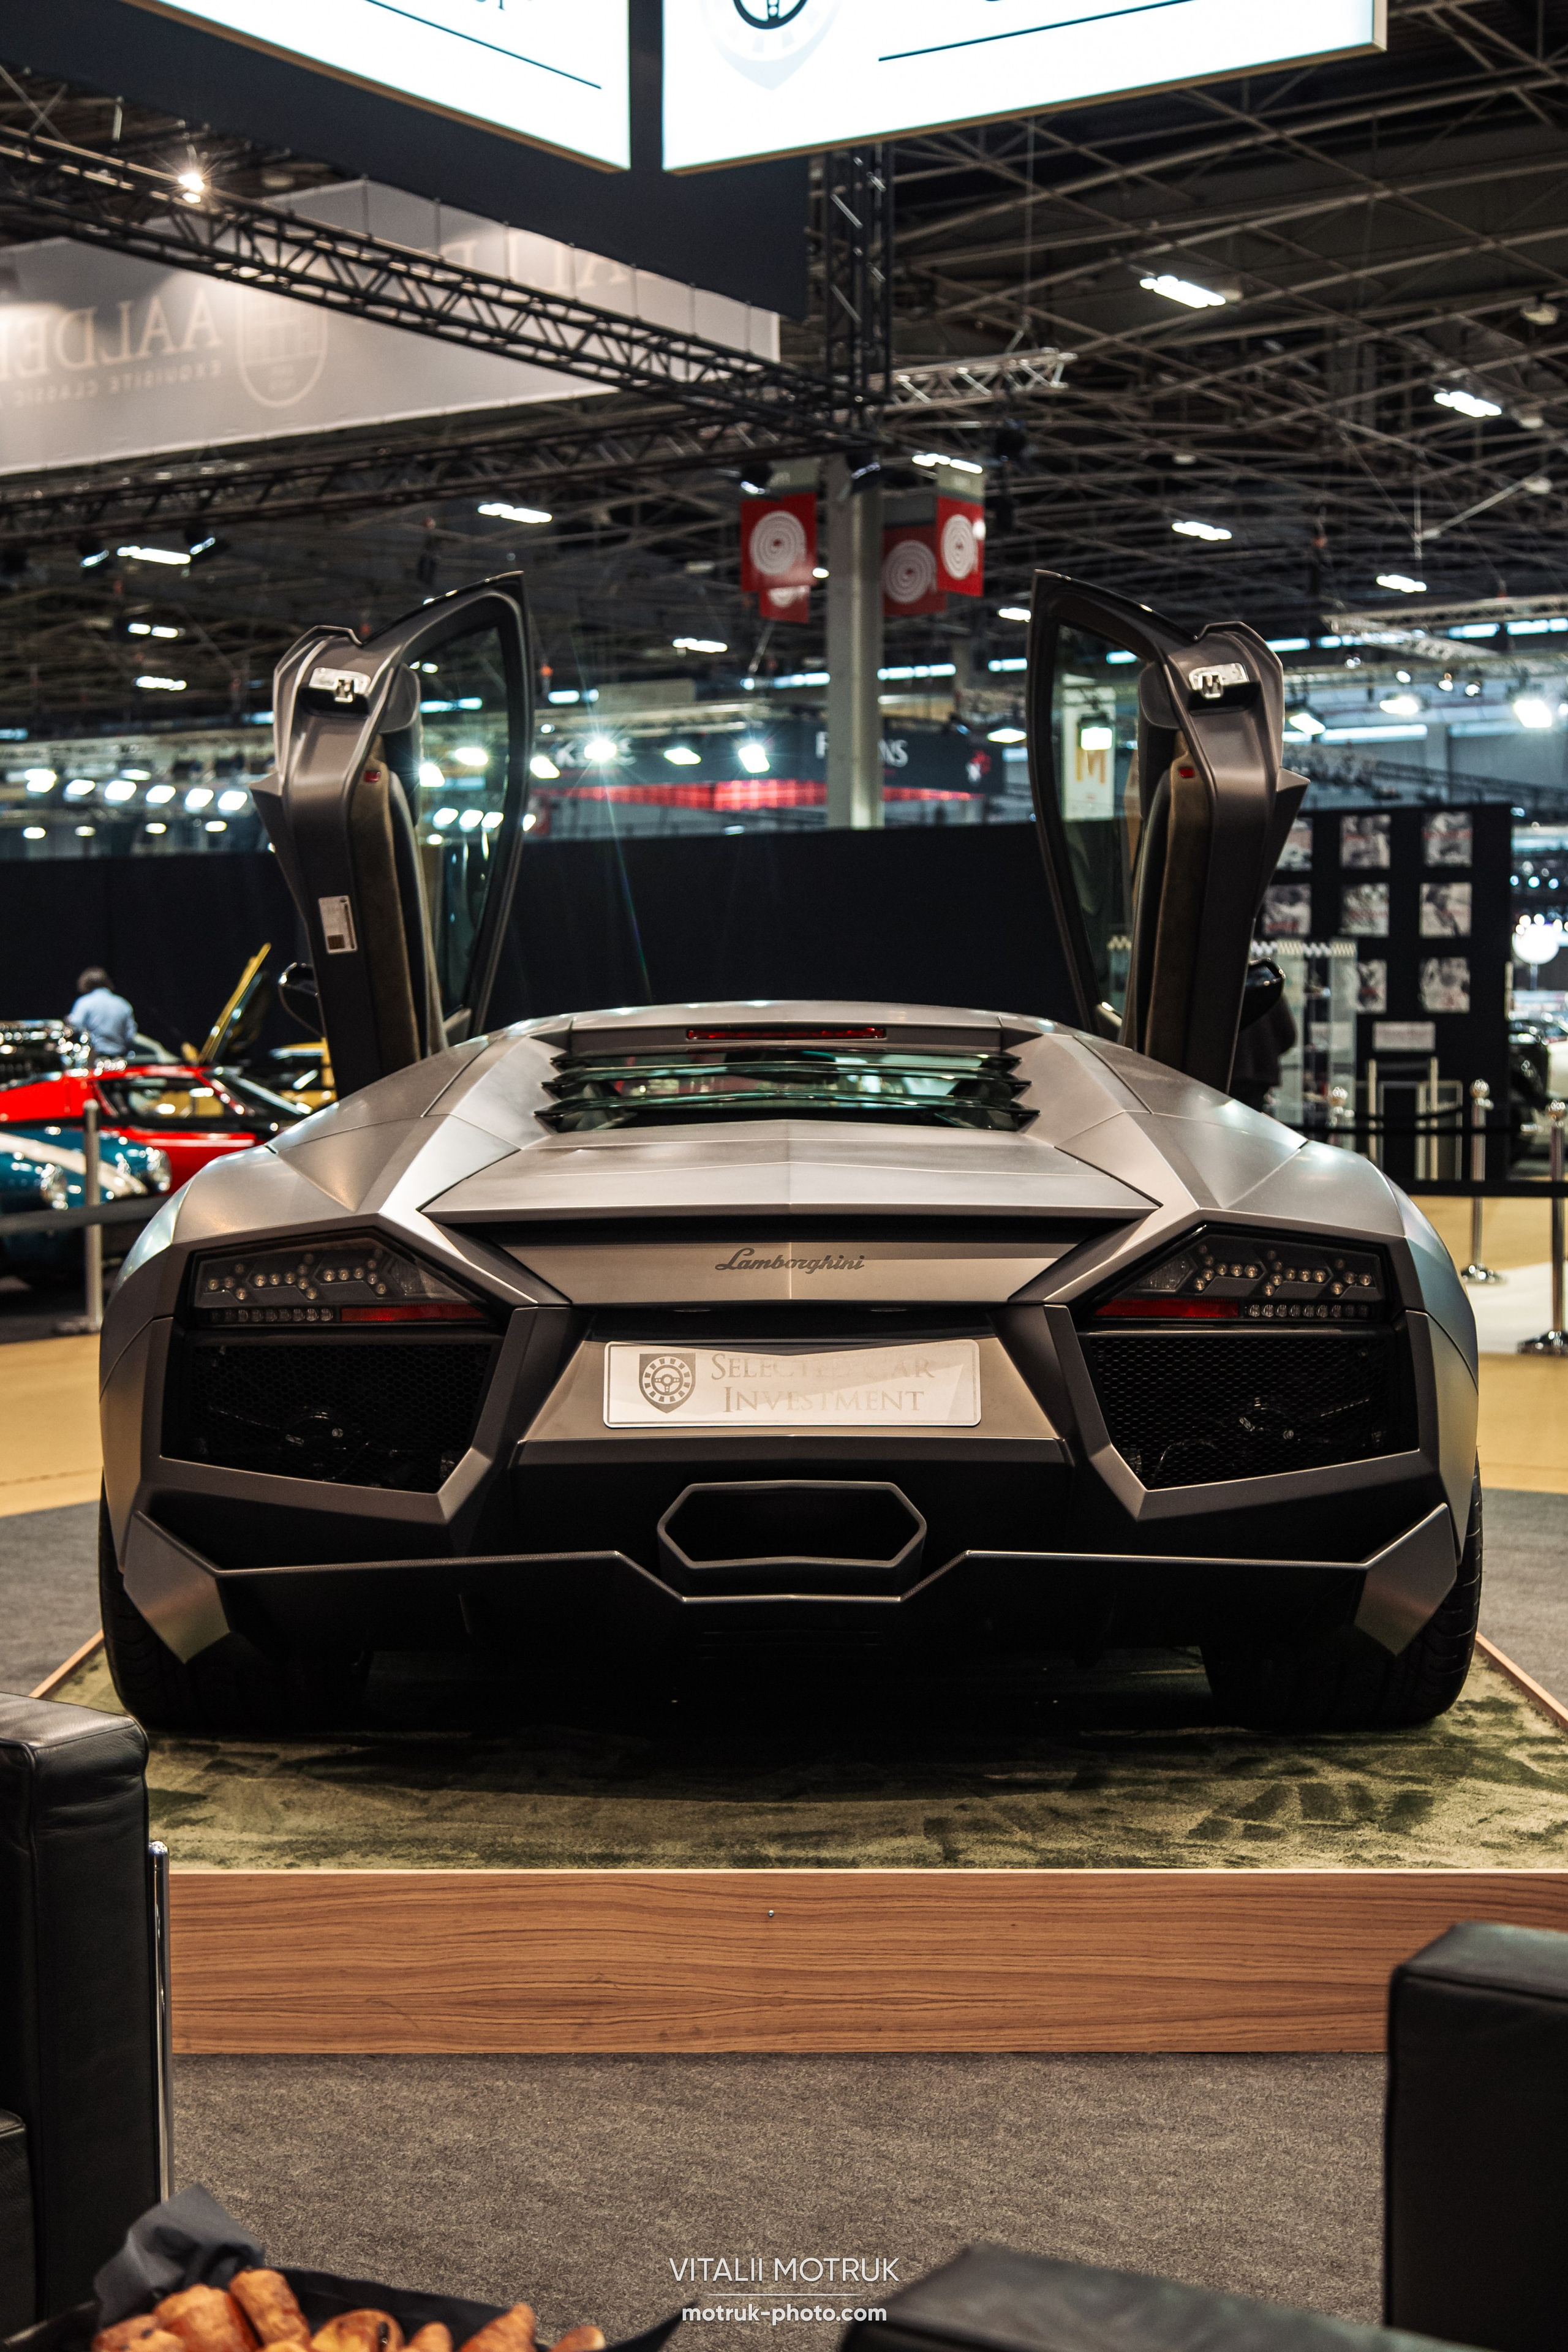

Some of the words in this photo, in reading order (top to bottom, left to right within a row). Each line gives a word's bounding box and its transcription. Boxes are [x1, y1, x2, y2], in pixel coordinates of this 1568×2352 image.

[715, 1248, 865, 1274] Lamborghini
[711, 1352, 852, 1381] SELECTE
[863, 1351, 935, 1379] AR
[723, 1387, 924, 1412] INVESTMENT
